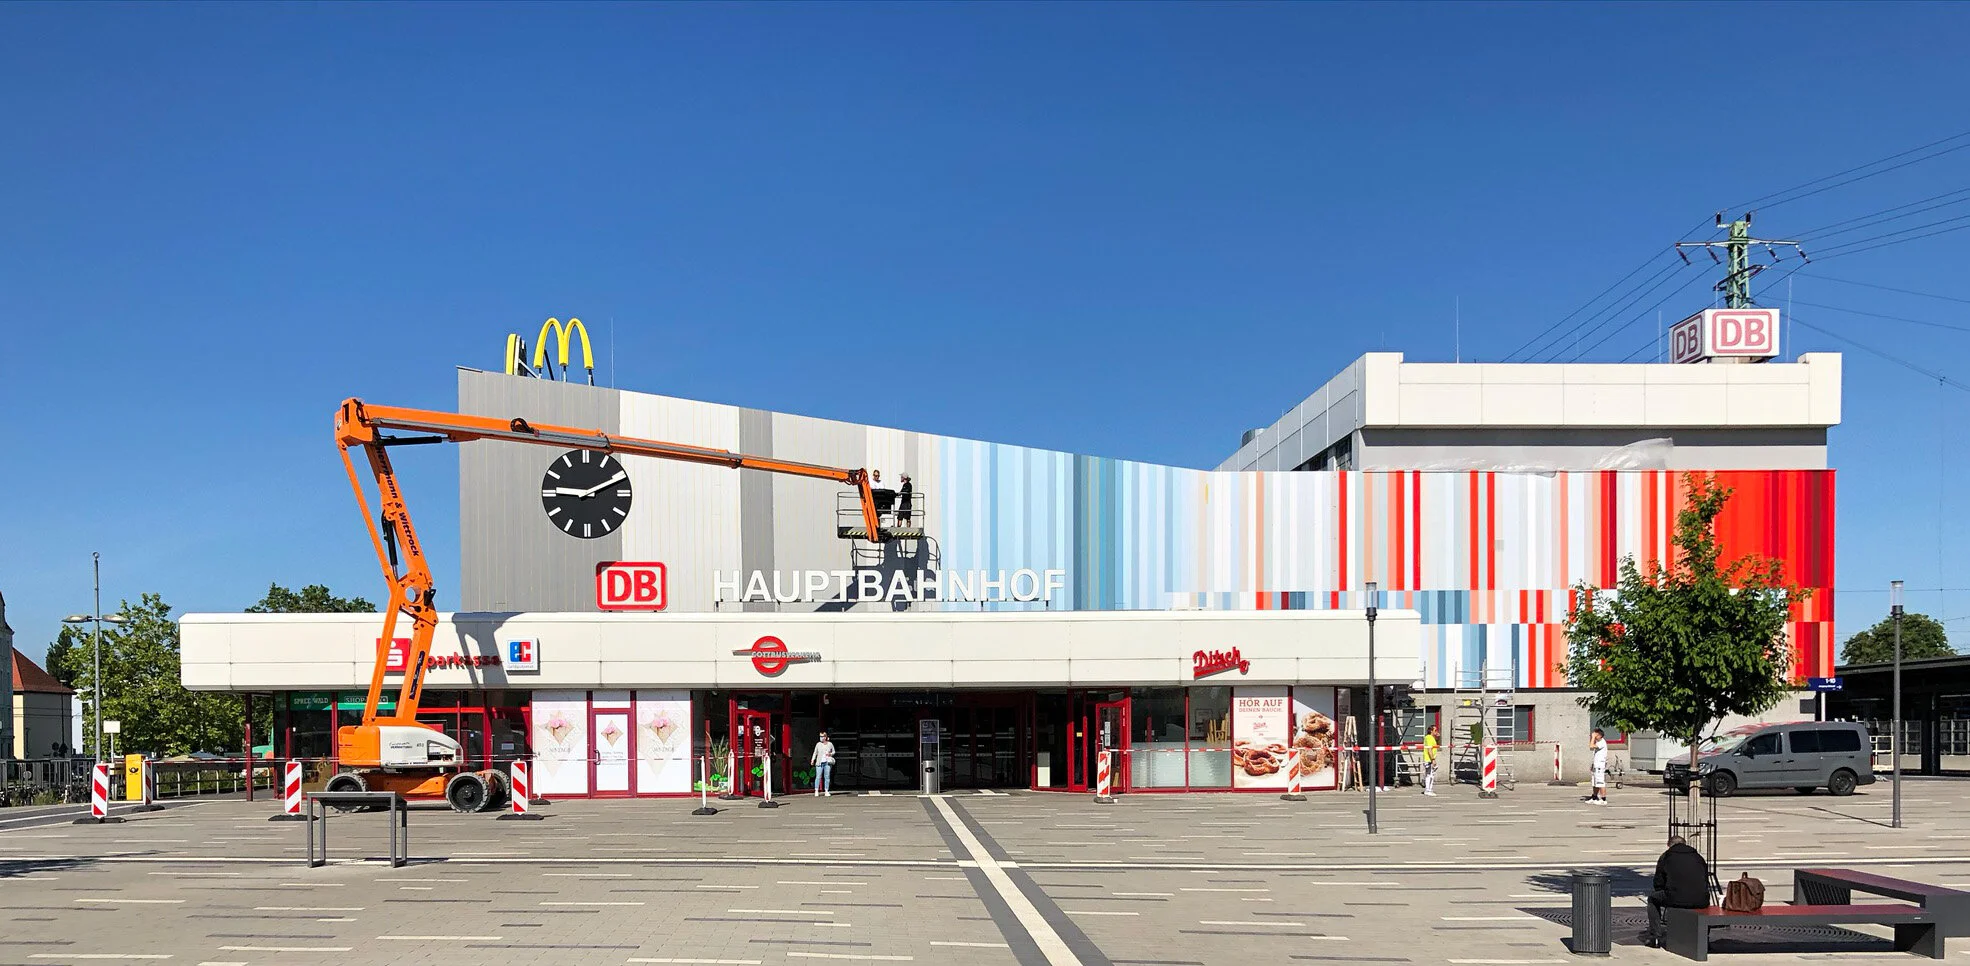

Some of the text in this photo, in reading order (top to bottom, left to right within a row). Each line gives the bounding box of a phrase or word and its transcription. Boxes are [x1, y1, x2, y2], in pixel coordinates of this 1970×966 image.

[1676, 323, 1699, 360] DB
[1720, 318, 1766, 347] DB
[399, 512, 420, 557] Wittrock
[607, 569, 659, 603] DB
[713, 569, 1066, 602] HAUPTBAHNHOF
[426, 652, 499, 672] parkasse
[1193, 646, 1241, 677] Ditsch
[1239, 697, 1283, 707] HÖR AUF
